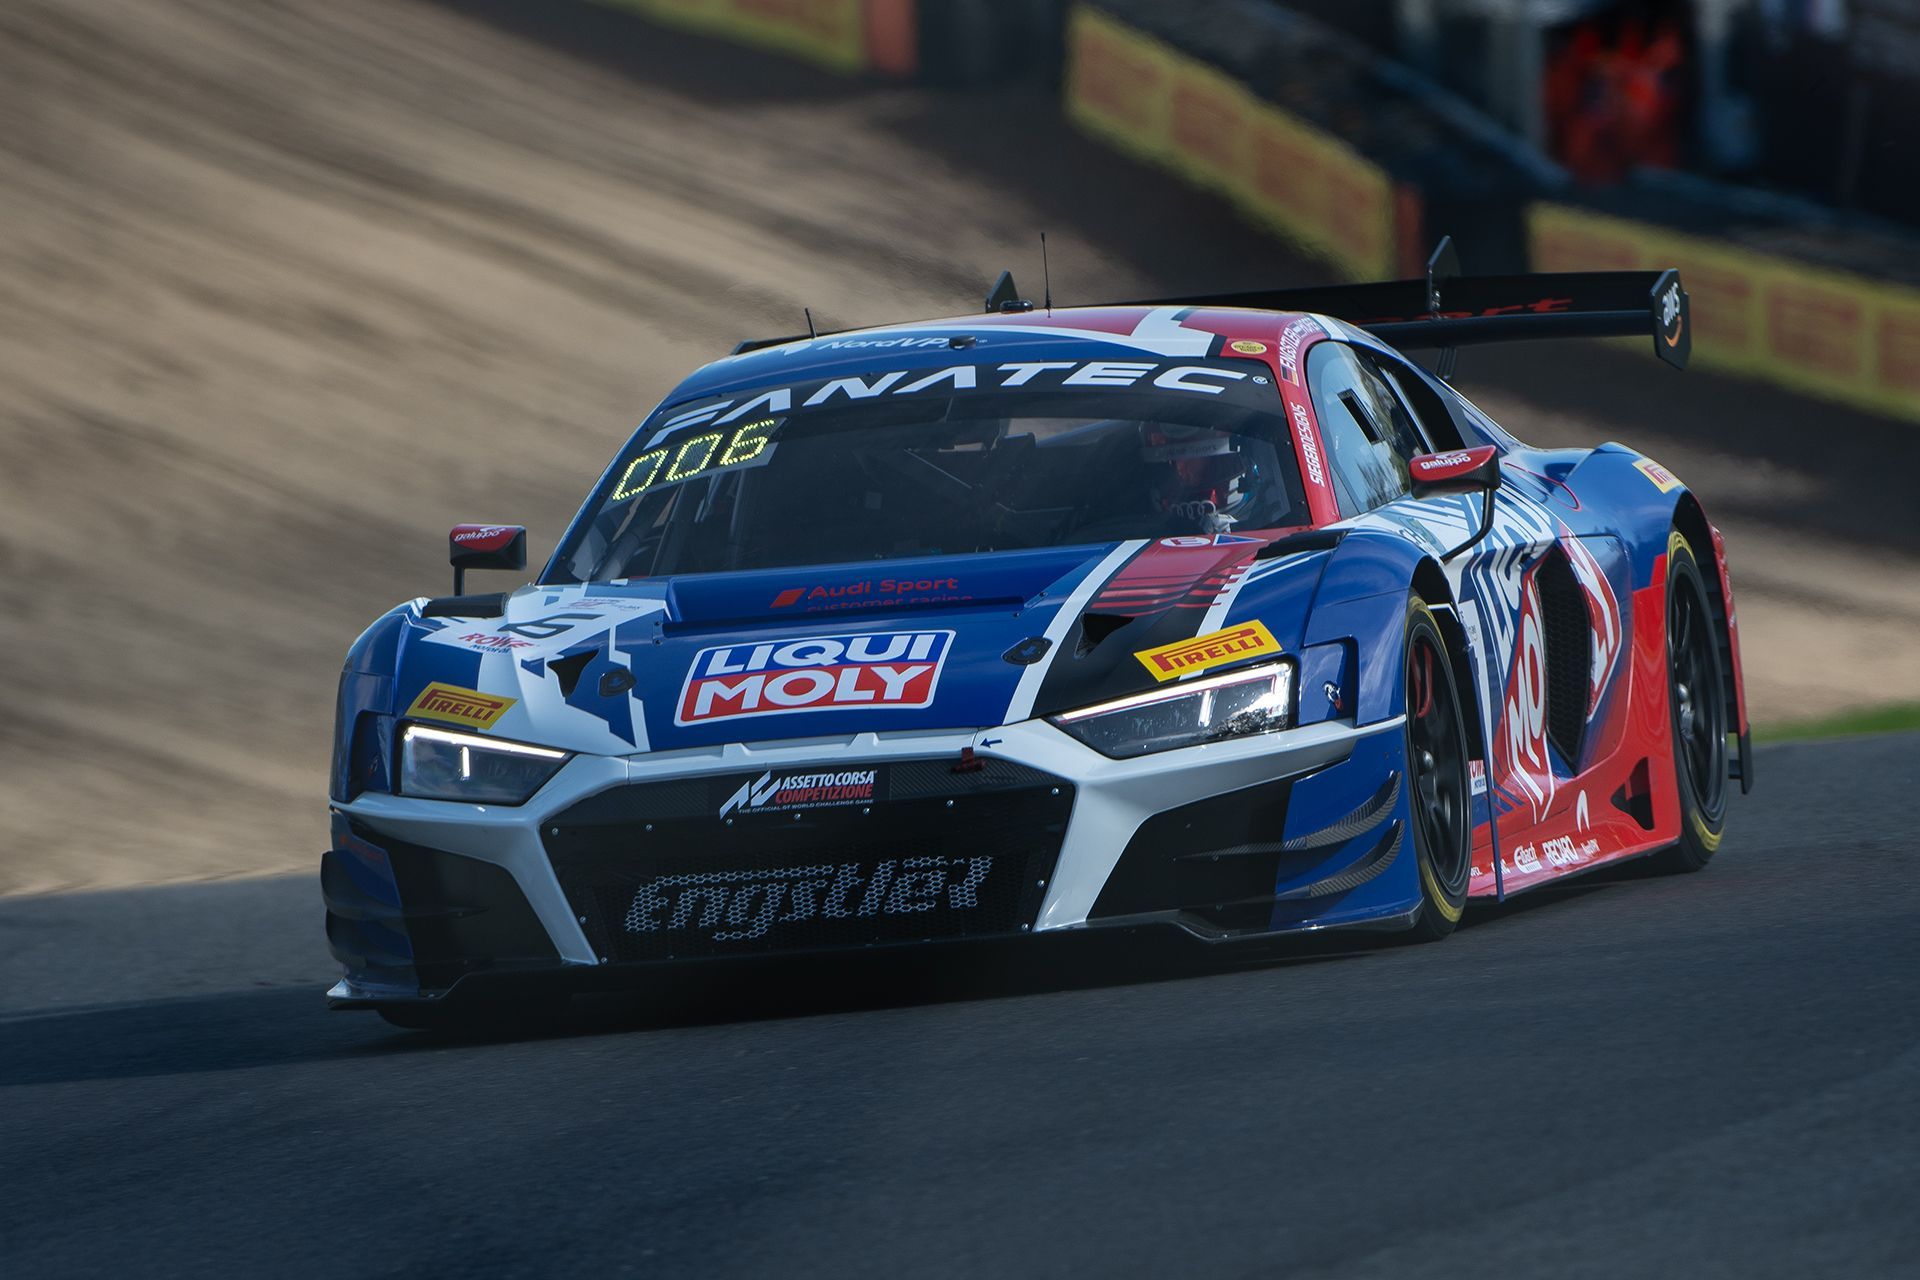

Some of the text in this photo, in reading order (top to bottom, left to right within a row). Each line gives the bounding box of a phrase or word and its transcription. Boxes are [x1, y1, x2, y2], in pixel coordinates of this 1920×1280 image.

[1662, 282, 1681, 326] aws
[816, 336, 951, 351] NordVP
[644, 361, 1248, 451] FANATEC
[612, 418, 775, 501] 006
[1290, 401, 1326, 488] SIEGERDESIGNS
[808, 577, 959, 599] Audi Sport
[458, 633, 535, 649] ROWE
[705, 634, 937, 676] LIQUI
[1150, 628, 1265, 672] PIRELLI
[418, 688, 504, 721] PIRELLI
[693, 665, 934, 717] MOLY
[775, 783, 873, 805] COMPETIZIONE
[781, 770, 876, 791] ASSETTO CORSA
[815, 799, 854, 808] CHALLENGE
[1542, 835, 1579, 866] RECARO
